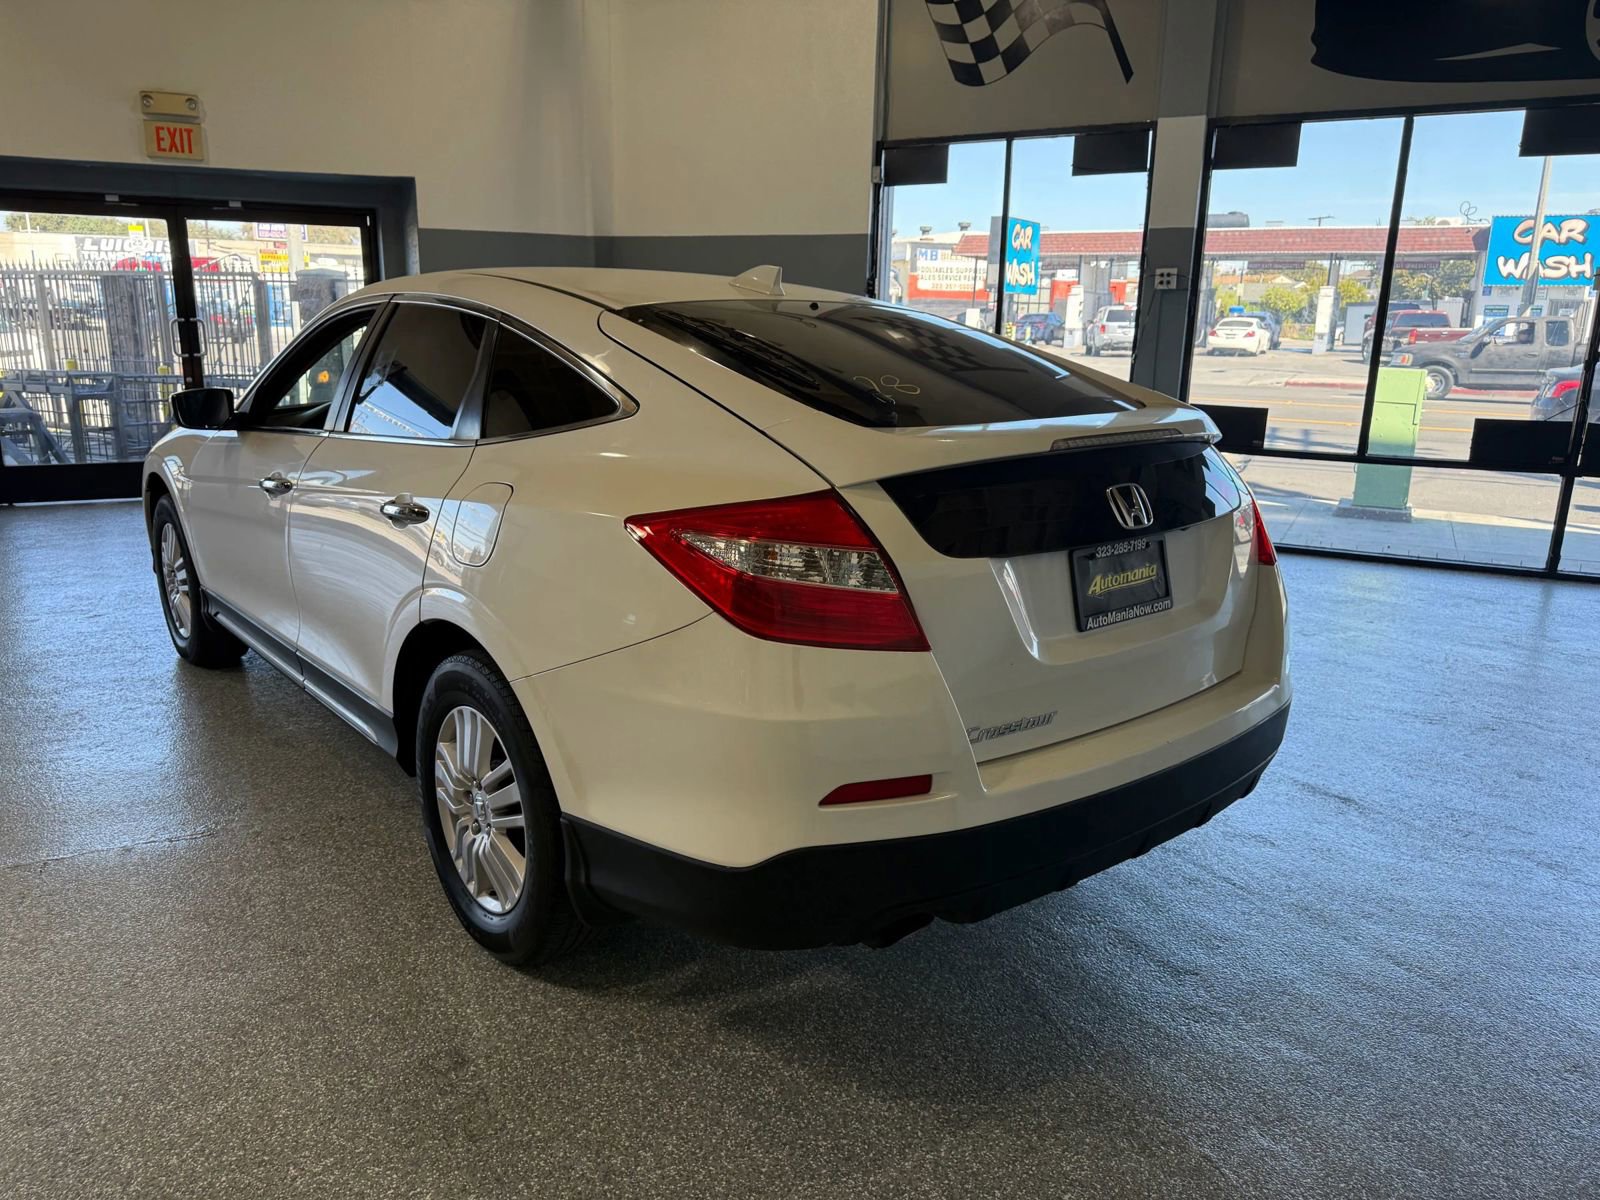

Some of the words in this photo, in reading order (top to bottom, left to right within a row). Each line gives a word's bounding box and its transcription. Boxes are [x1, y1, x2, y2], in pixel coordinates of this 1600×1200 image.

[155, 126, 193, 154] EXIT
[1011, 223, 1033, 251] CAR
[1513, 219, 1588, 244] CAR
[918, 248, 939, 261] MB
[1006, 258, 1036, 287] WASH
[1087, 563, 1157, 596] Automania
[1086, 600, 1171, 630] AutoManiaNow.com
[966, 710, 1058, 744] Crosstour
